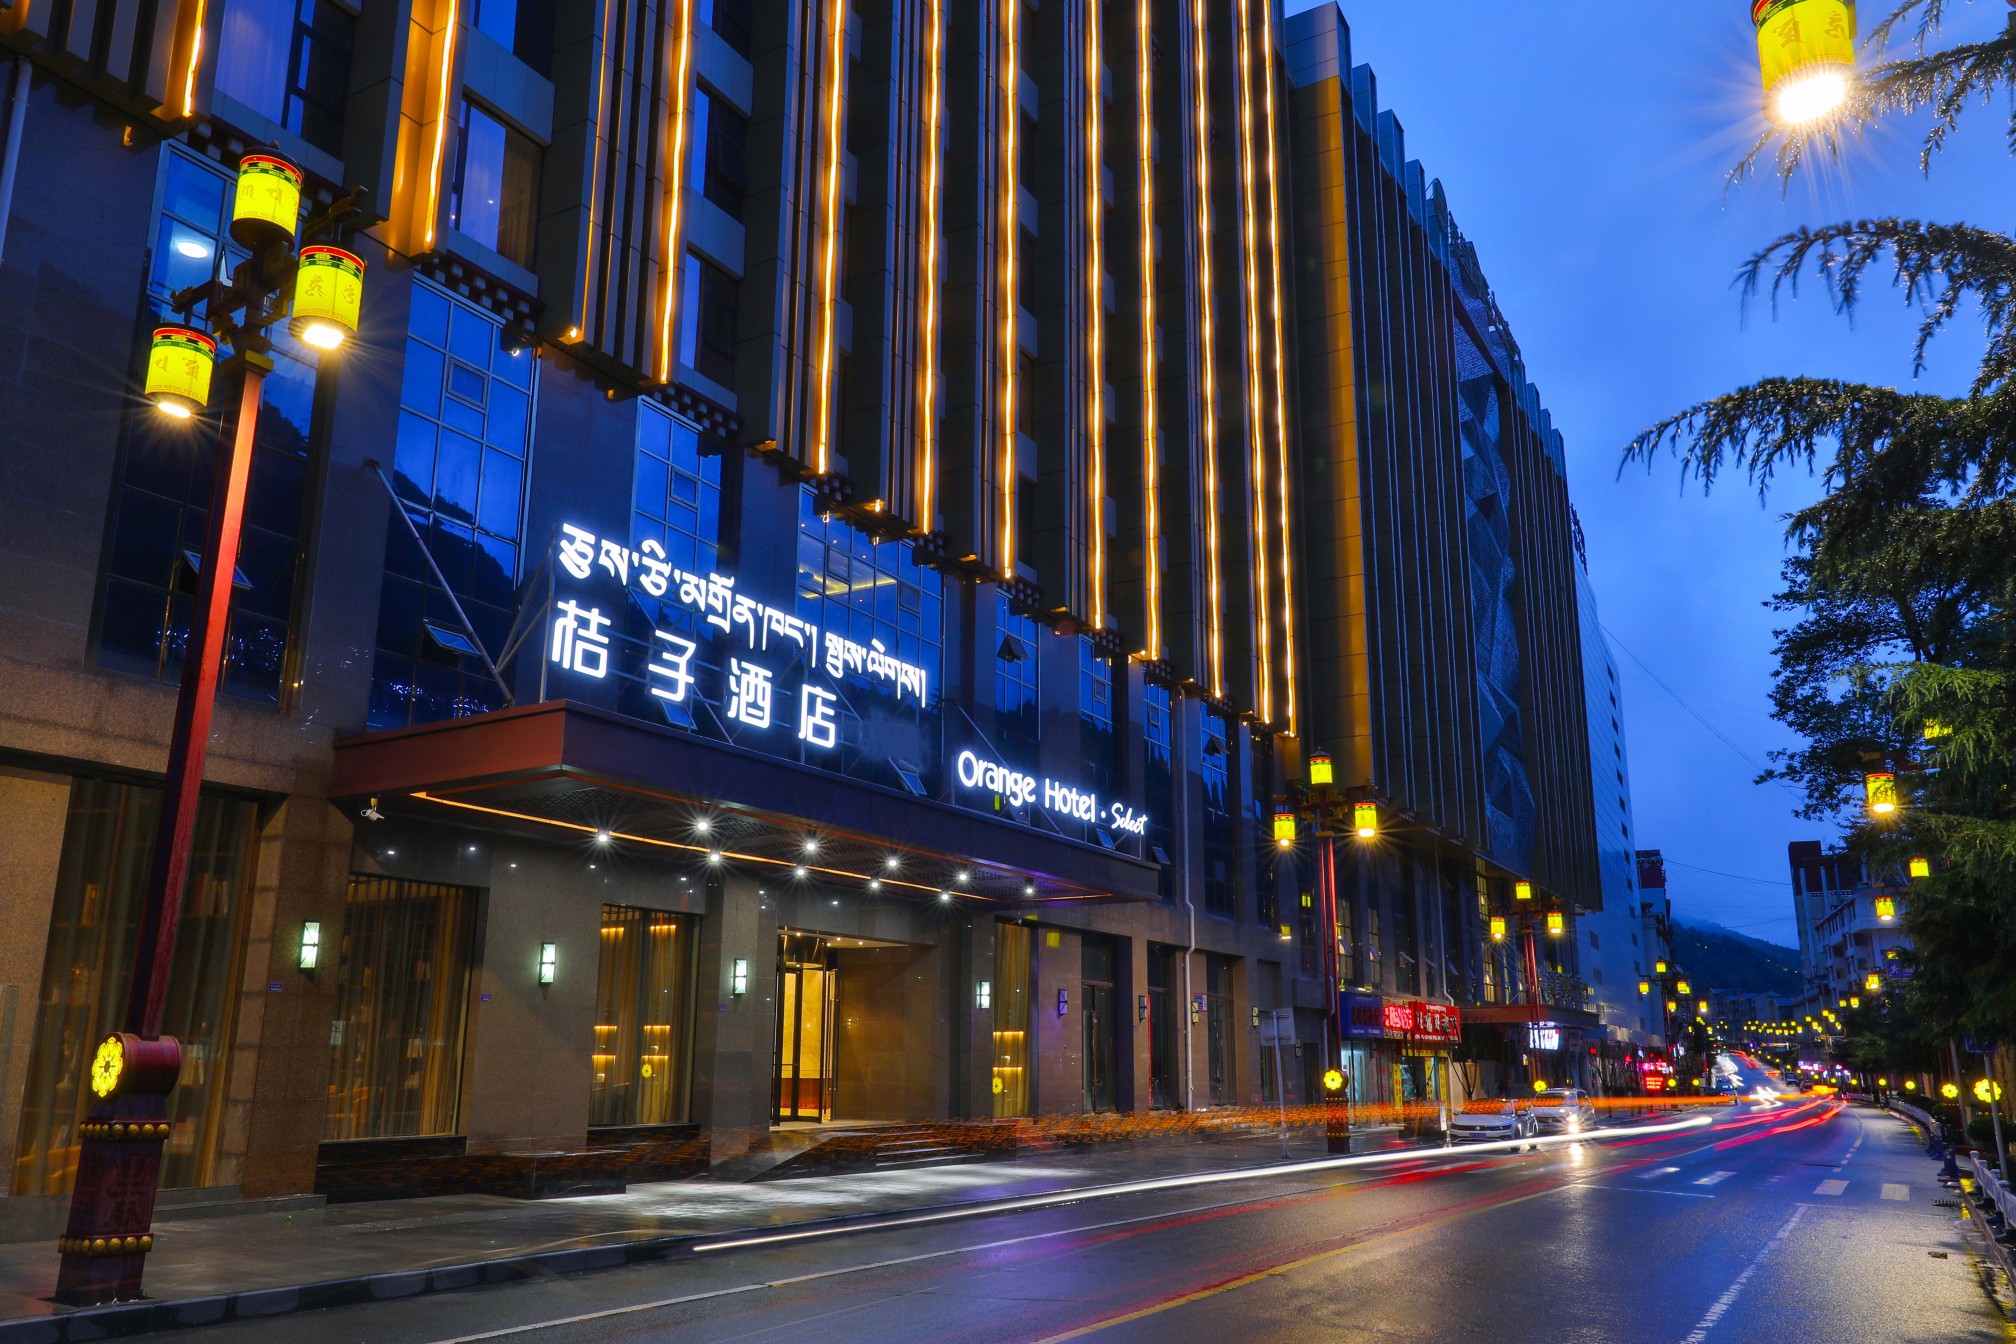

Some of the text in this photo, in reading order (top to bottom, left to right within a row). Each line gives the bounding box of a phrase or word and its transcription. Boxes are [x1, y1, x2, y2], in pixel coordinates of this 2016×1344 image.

[551, 599, 838, 749] 桔子酒店
[957, 750, 1037, 807] Orange
[1044, 777, 1096, 823] Hotel
[1111, 802, 1148, 835] Select
